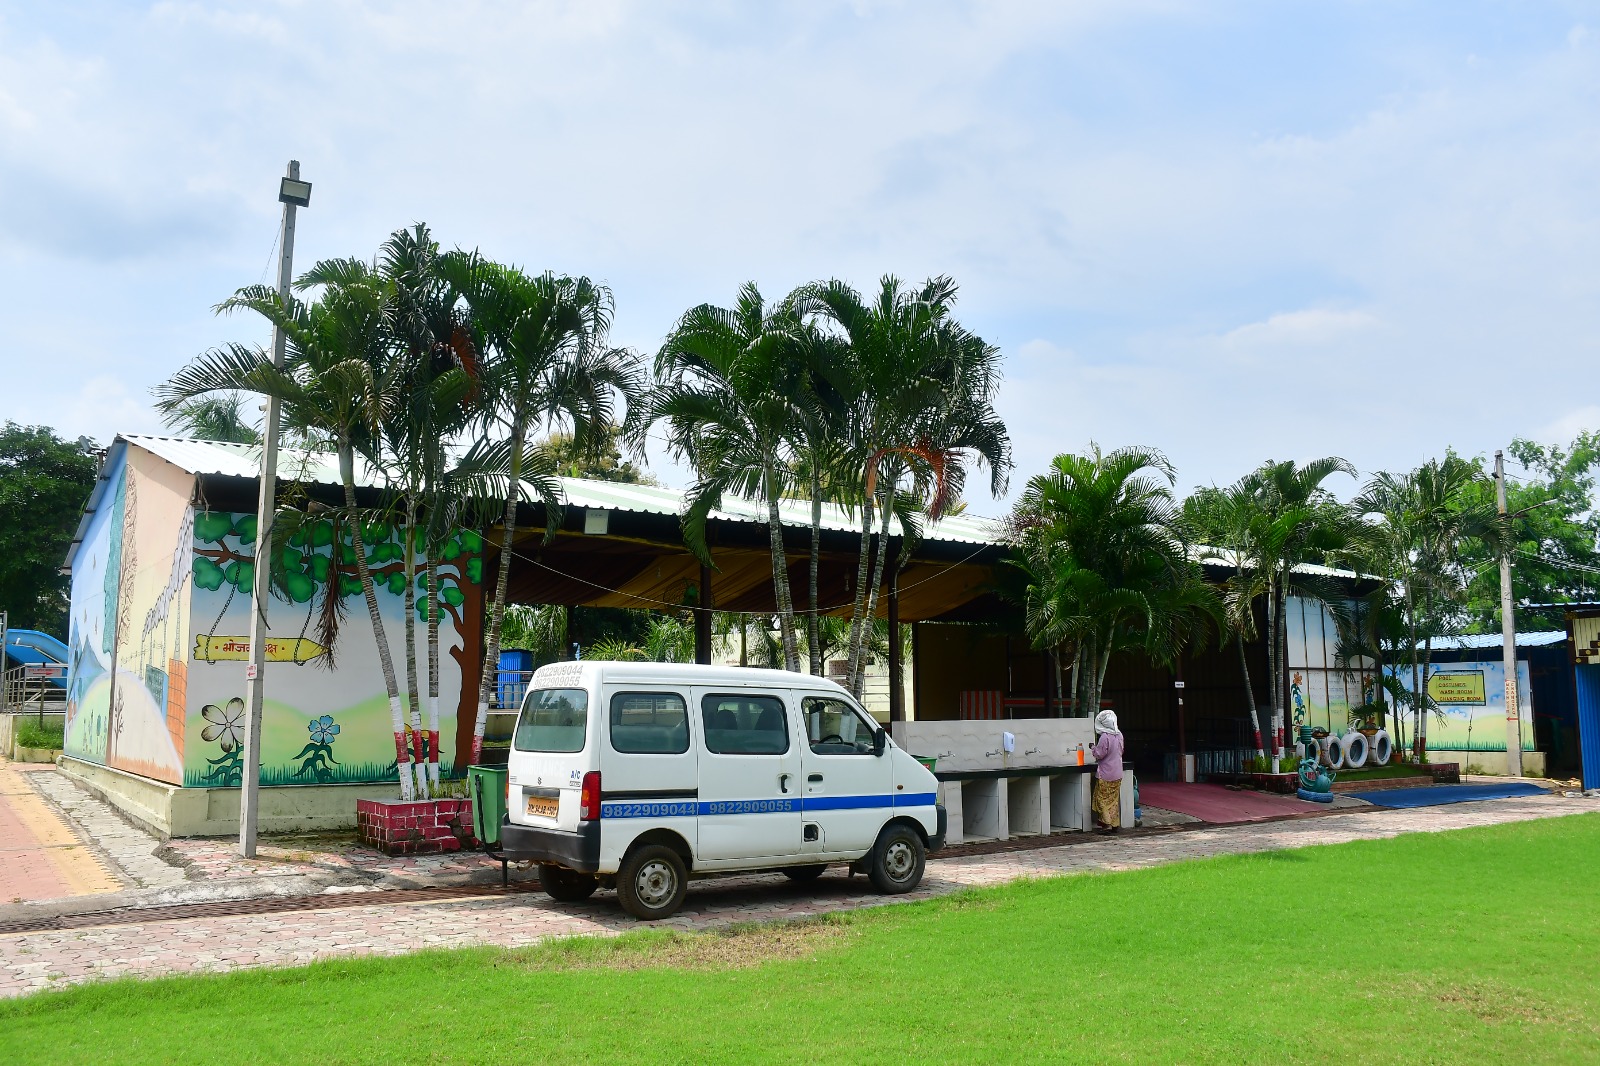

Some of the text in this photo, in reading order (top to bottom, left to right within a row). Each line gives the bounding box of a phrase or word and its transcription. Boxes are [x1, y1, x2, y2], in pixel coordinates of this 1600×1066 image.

[570, 769, 581, 779] A/C
[603, 800, 792, 817] 9822909044 9822909055
